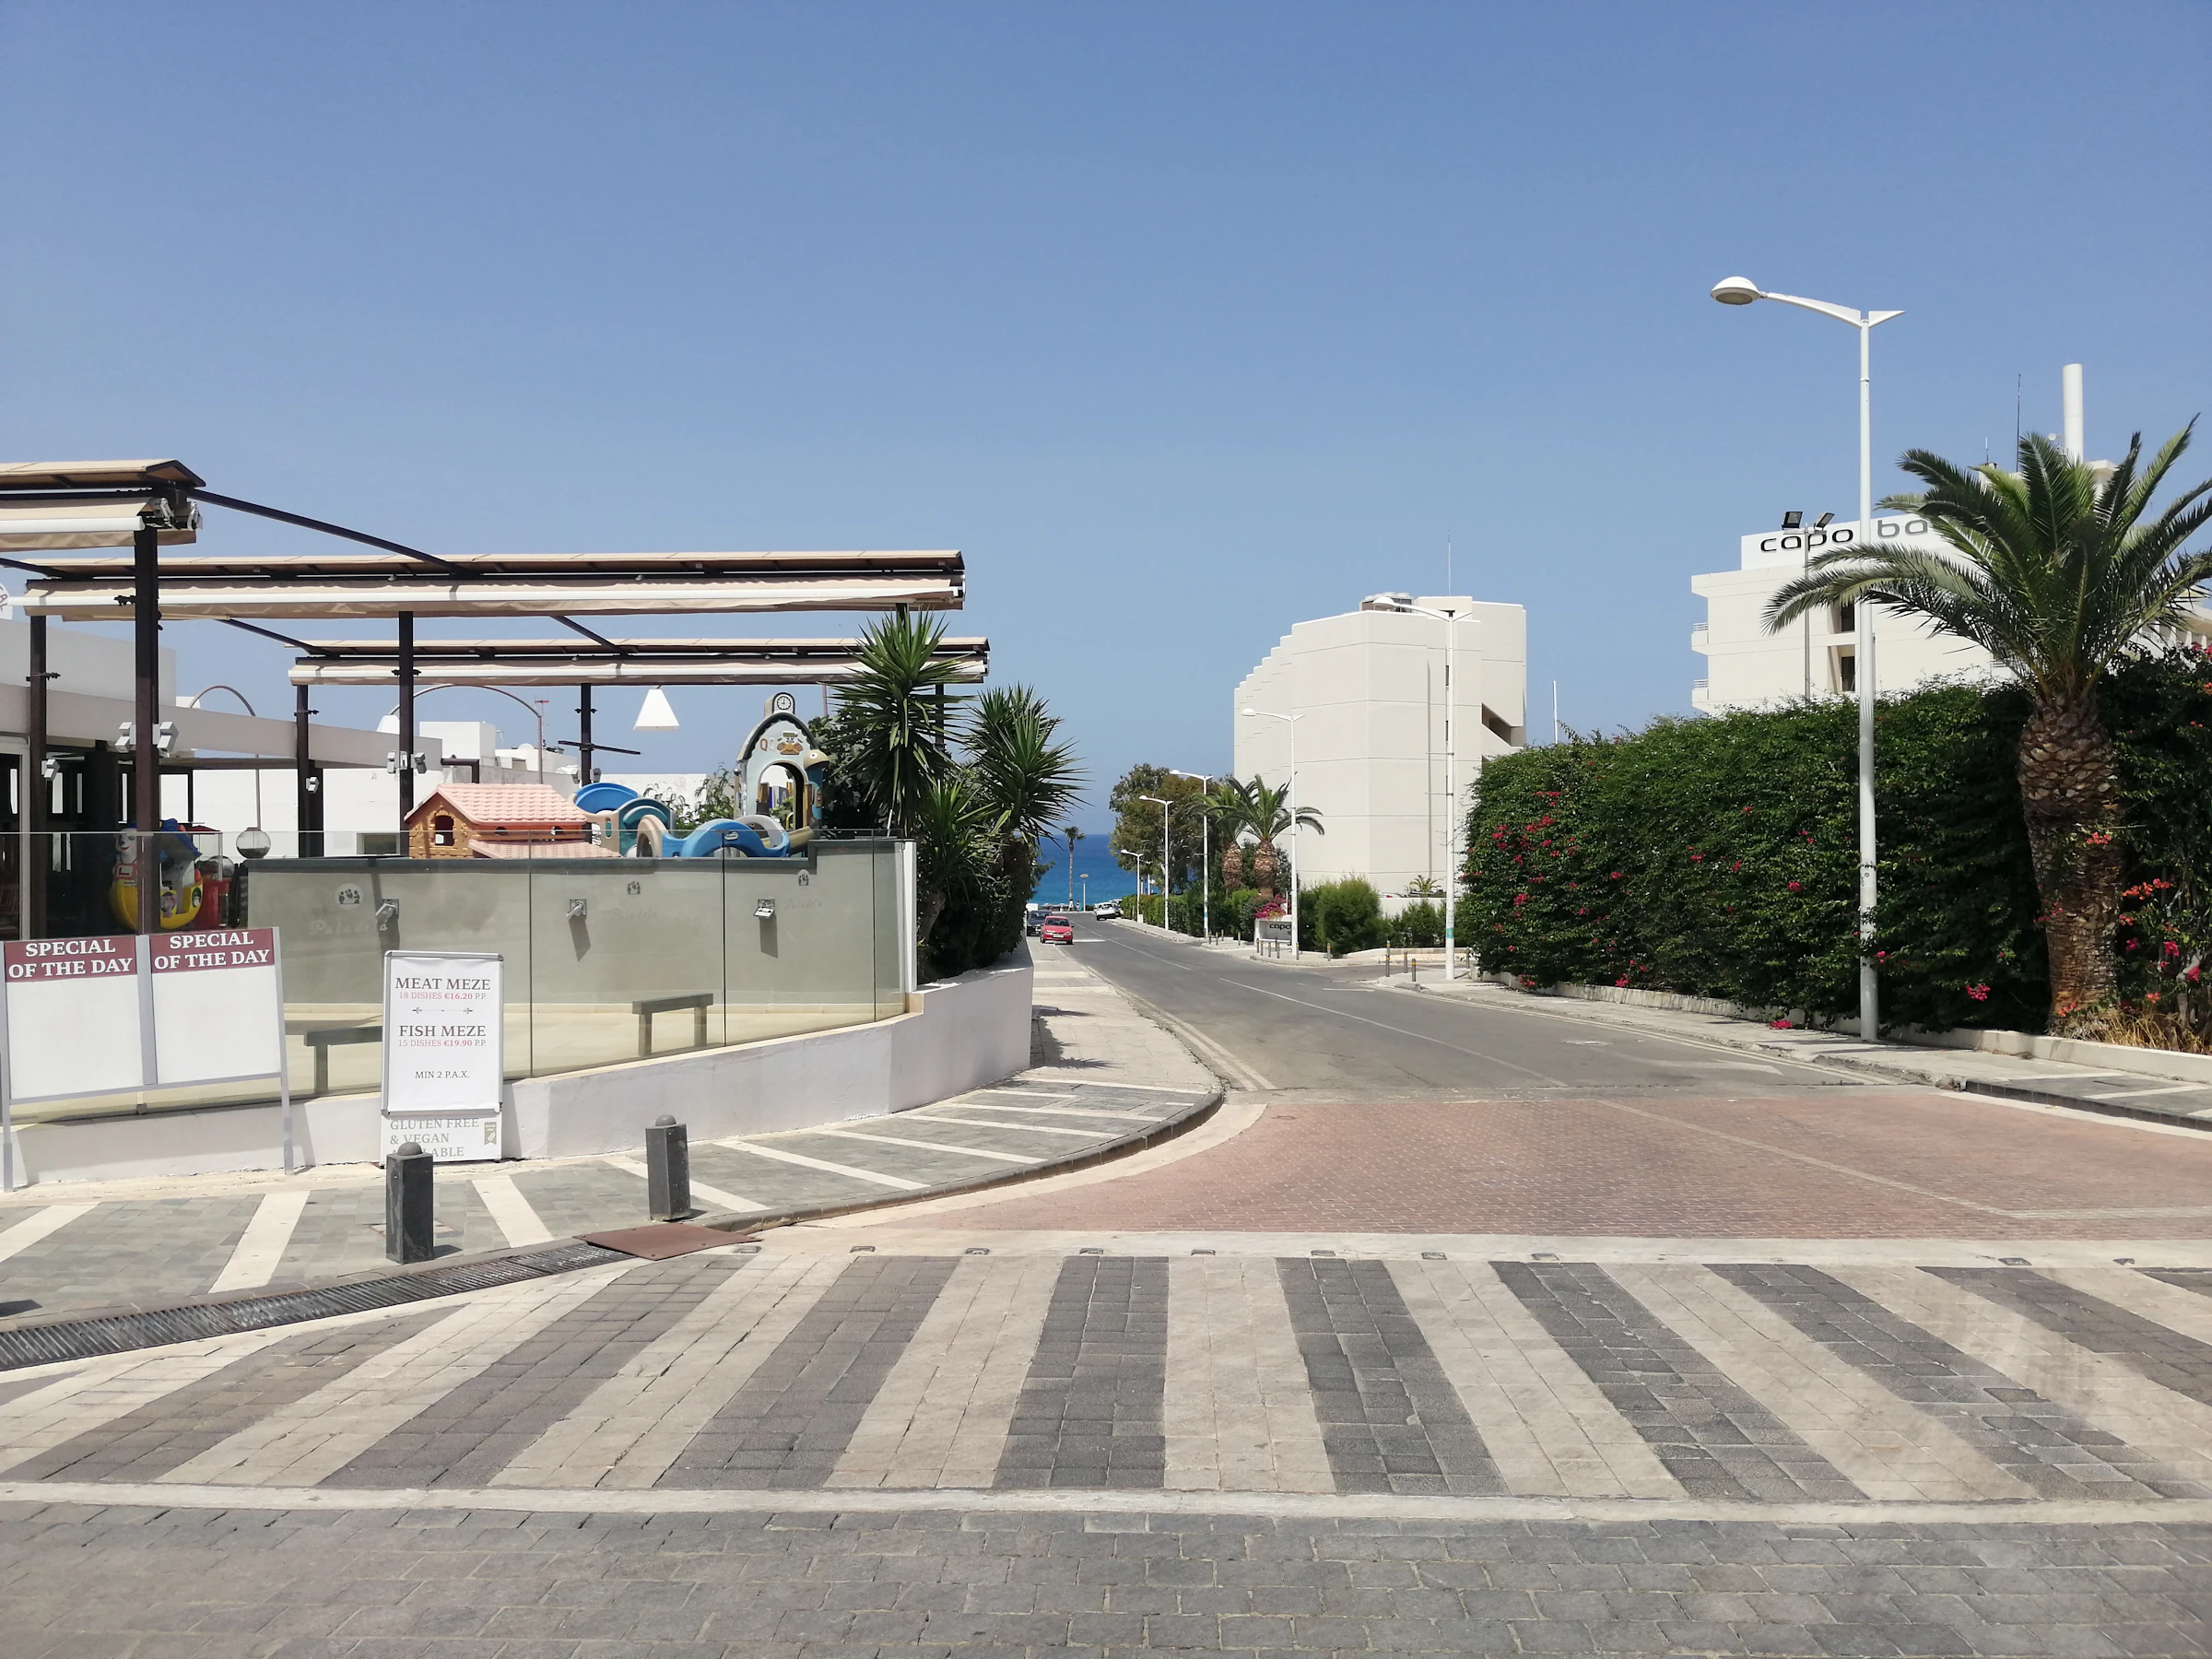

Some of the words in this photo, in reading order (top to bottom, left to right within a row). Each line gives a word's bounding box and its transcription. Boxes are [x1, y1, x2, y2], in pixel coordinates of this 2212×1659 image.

[1760, 528, 1853, 552] capo
[1877, 519, 1929, 539] ba
[170, 932, 254, 949] SPECIAL
[25, 939, 116, 957] SPECIAL
[154, 955, 181, 970] OF
[185, 952, 228, 968] THE
[229, 948, 271, 965] DAY
[8, 964, 37, 979] OF
[41, 960, 86, 976] THE
[91, 958, 134, 973] DAY
[395, 977, 442, 990] MEAT
[446, 978, 491, 990] MEZE
[411, 992, 442, 1000] DISHES
[399, 1025, 436, 1037] FISH
[441, 1025, 486, 1037] MEZE
[415, 1071, 435, 1079] MIN
[445, 1070, 470, 1078] P.A.X.
[390, 1119, 442, 1130] GLUTEN
[446, 1117, 479, 1128] FREE
[389, 1135, 399, 1145] &
[403, 1133, 450, 1144] VEGAN
